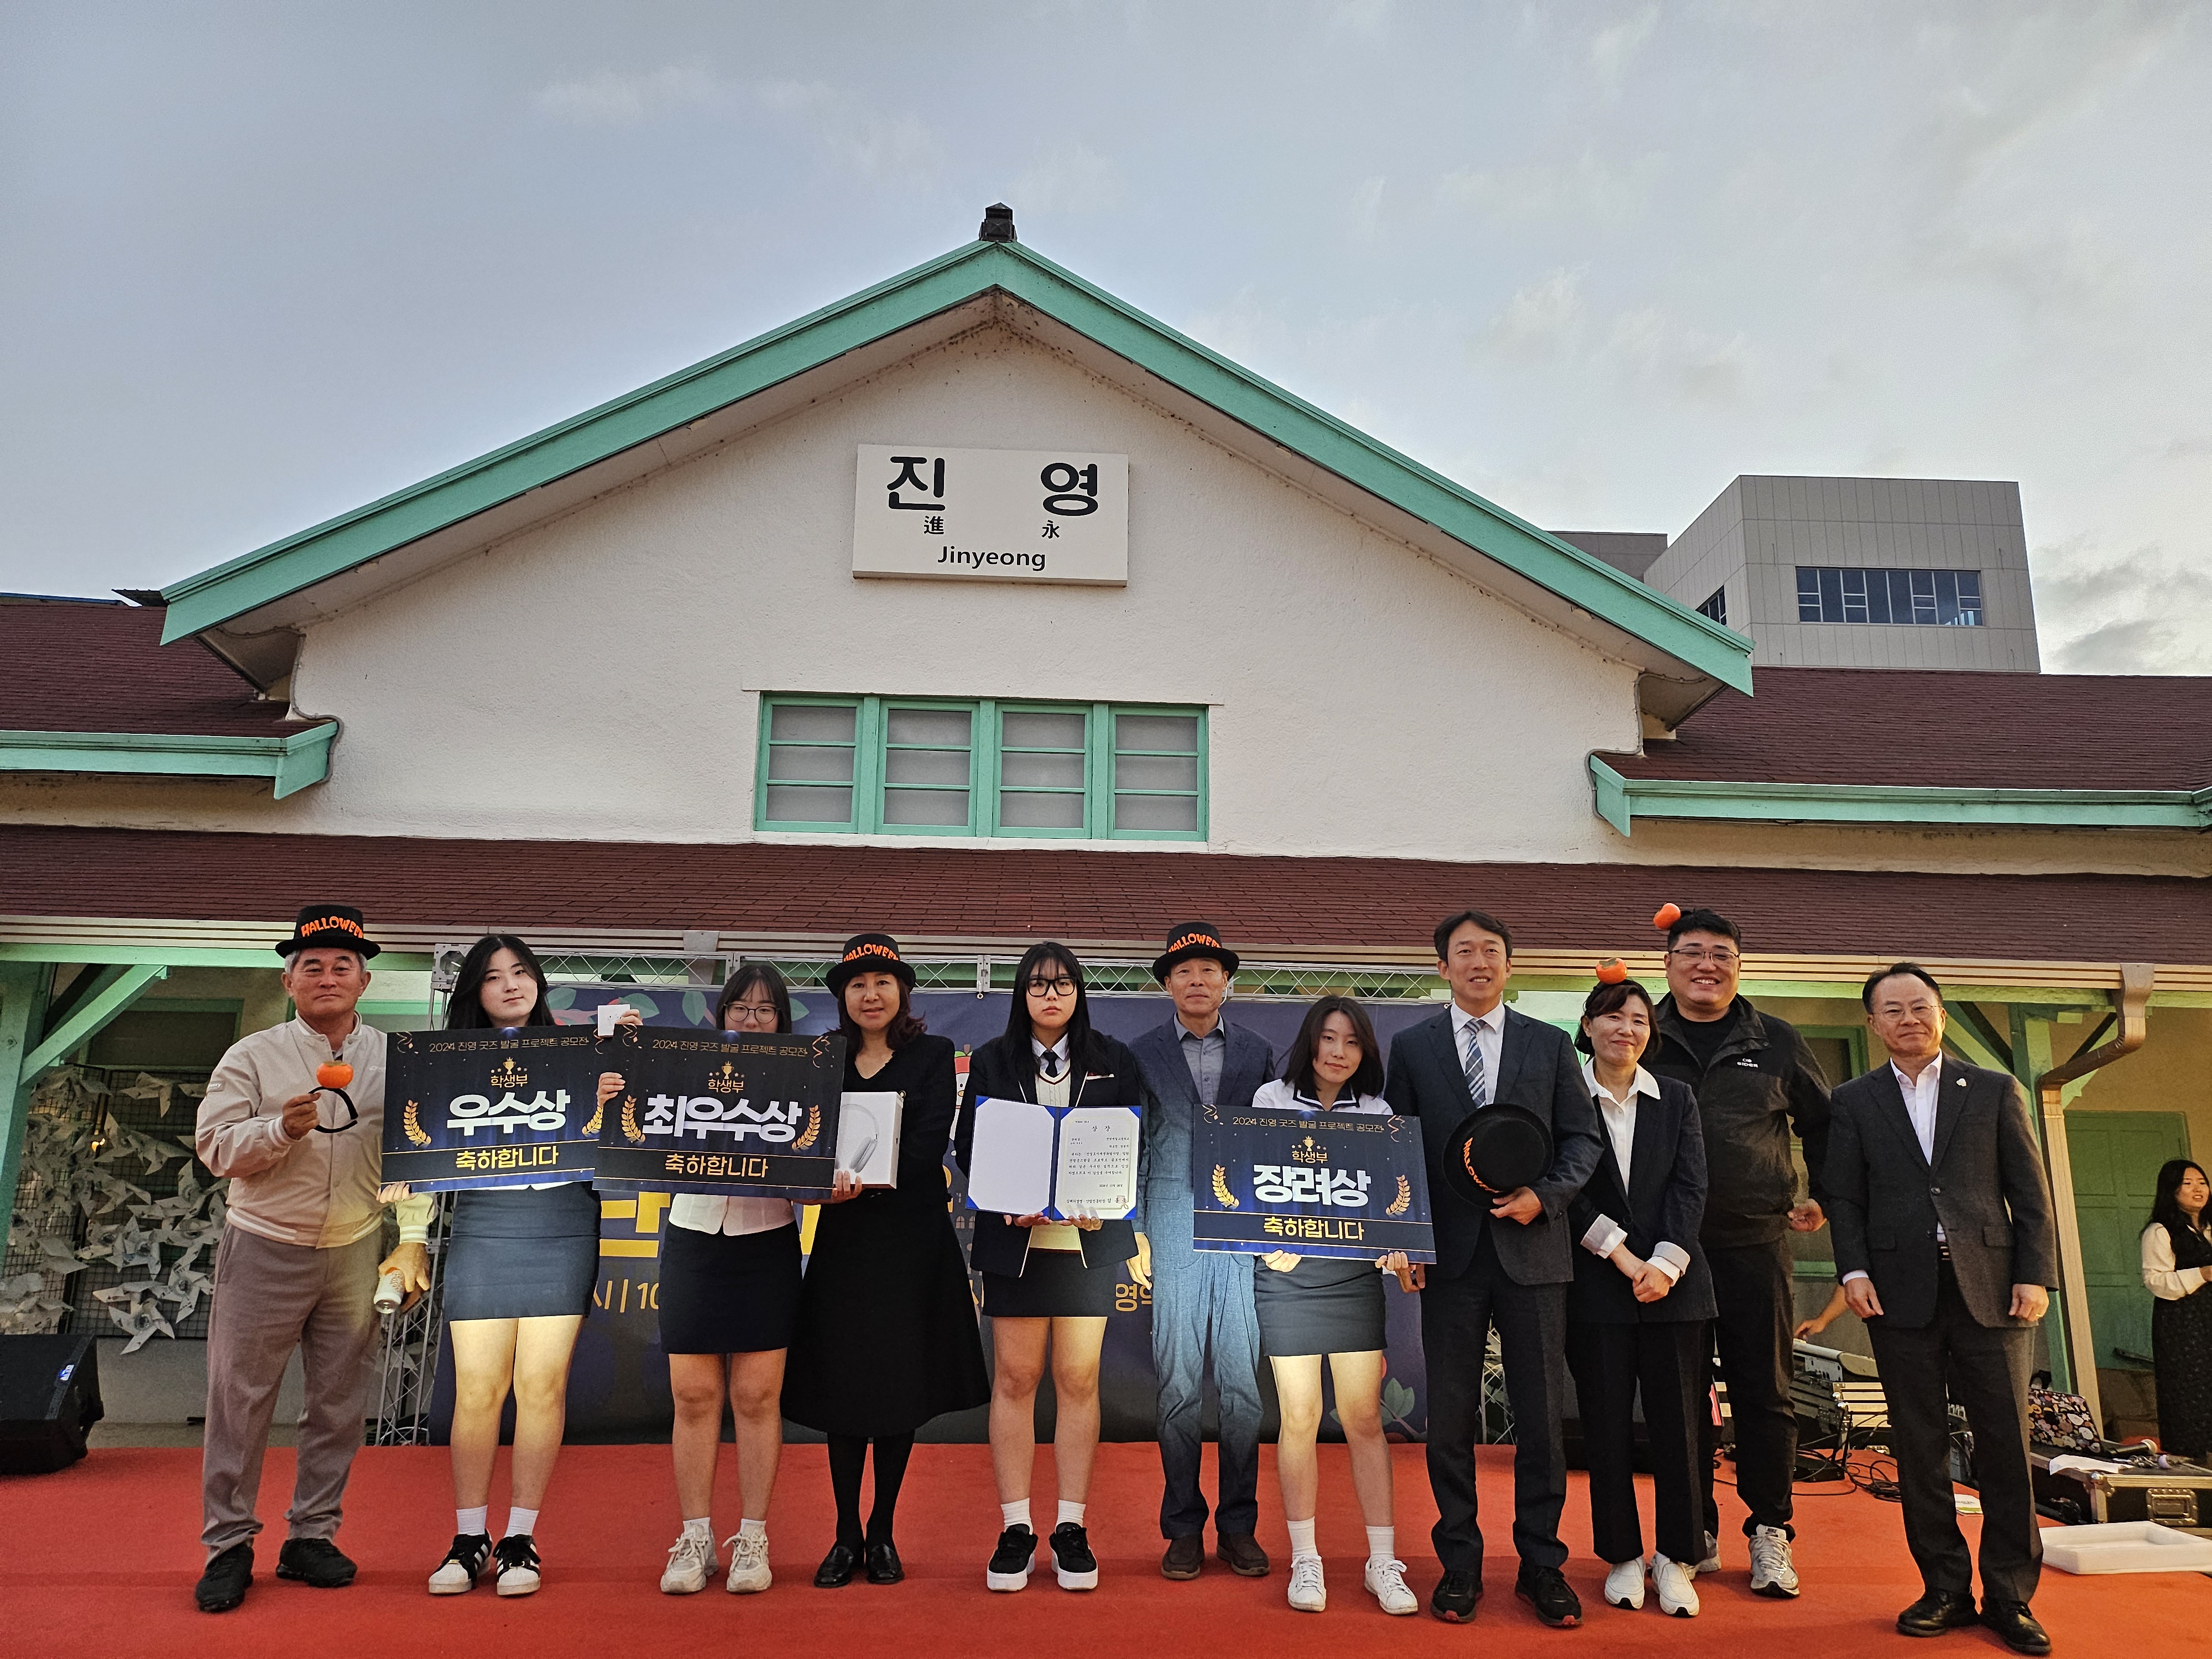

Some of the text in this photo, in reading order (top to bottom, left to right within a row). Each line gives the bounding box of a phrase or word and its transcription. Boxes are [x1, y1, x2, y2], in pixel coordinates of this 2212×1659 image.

[937, 546, 1046, 572] Jinyeong
[429, 1037, 588, 1052] 2024 진영 굿즈 발굴 프로젝트 공모전
[653, 1039, 807, 1057] 2024 진영 굿즈 발굴 프로젝트 공모전
[490, 1074, 529, 1088] 학생부
[707, 1078, 744, 1093] 학생부
[446, 1089, 571, 1136] 우수상
[642, 1093, 803, 1143] 최우수상
[1233, 1117, 1384, 1133] 2024 진영 굿즈 발굴 프로젝트 공모전
[455, 1145, 559, 1171] 축하합니다
[665, 1153, 769, 1178] 축하합니다
[1291, 1150, 1328, 1164] 학생부
[1253, 1164, 1371, 1208] 장려상
[1263, 1216, 1365, 1241] 축하합니다
